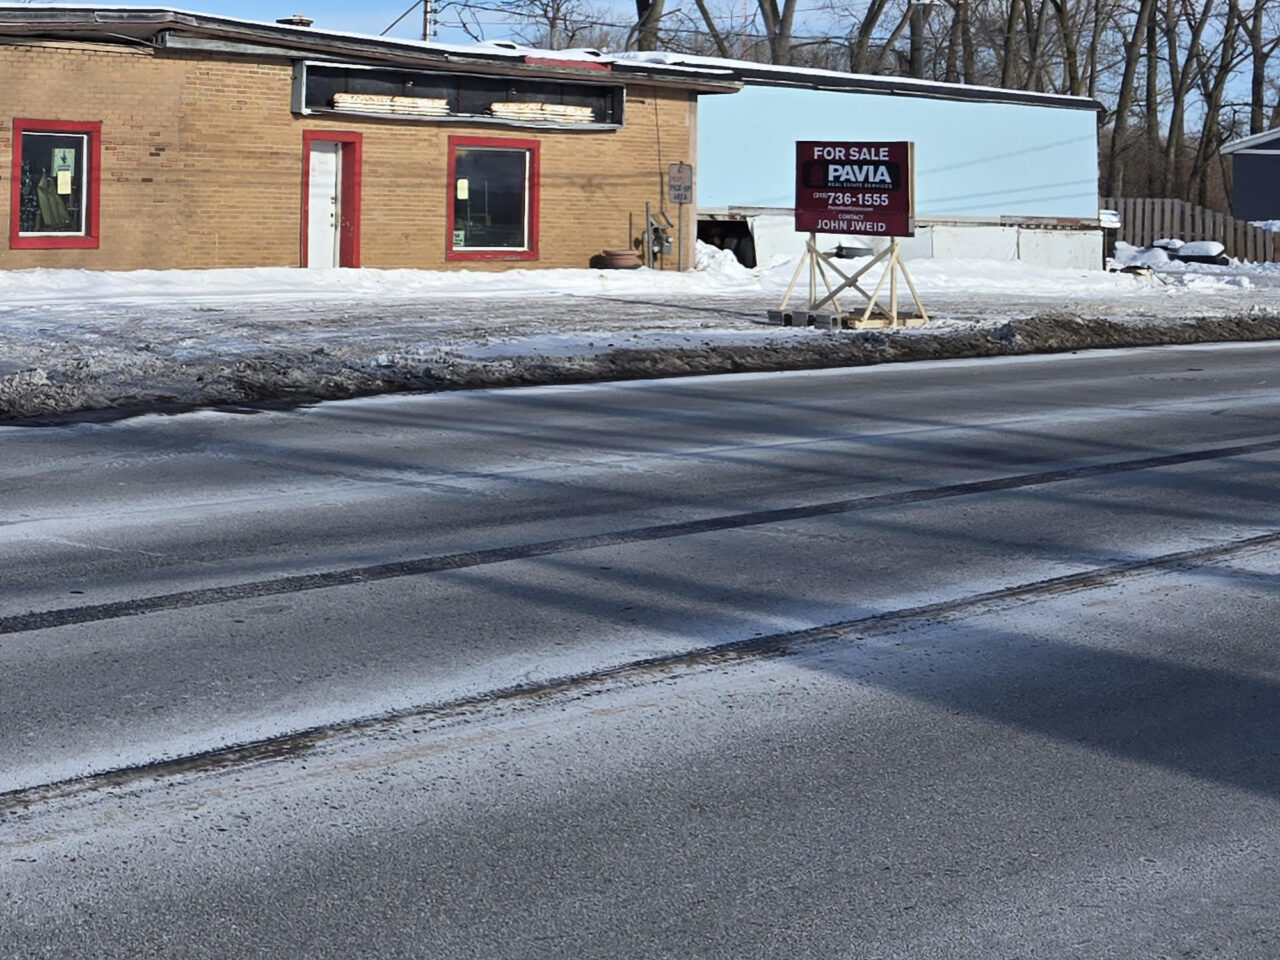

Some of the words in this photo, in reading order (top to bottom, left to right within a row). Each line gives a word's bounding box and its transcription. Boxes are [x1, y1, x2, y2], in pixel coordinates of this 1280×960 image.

[813, 147, 845, 160] FOR
[849, 147, 889, 160] SALE
[828, 164, 891, 183] PAVIA
[827, 192, 889, 206] 736-1555
[817, 219, 847, 230] JOHN
[850, 221, 886, 232] JWEID
